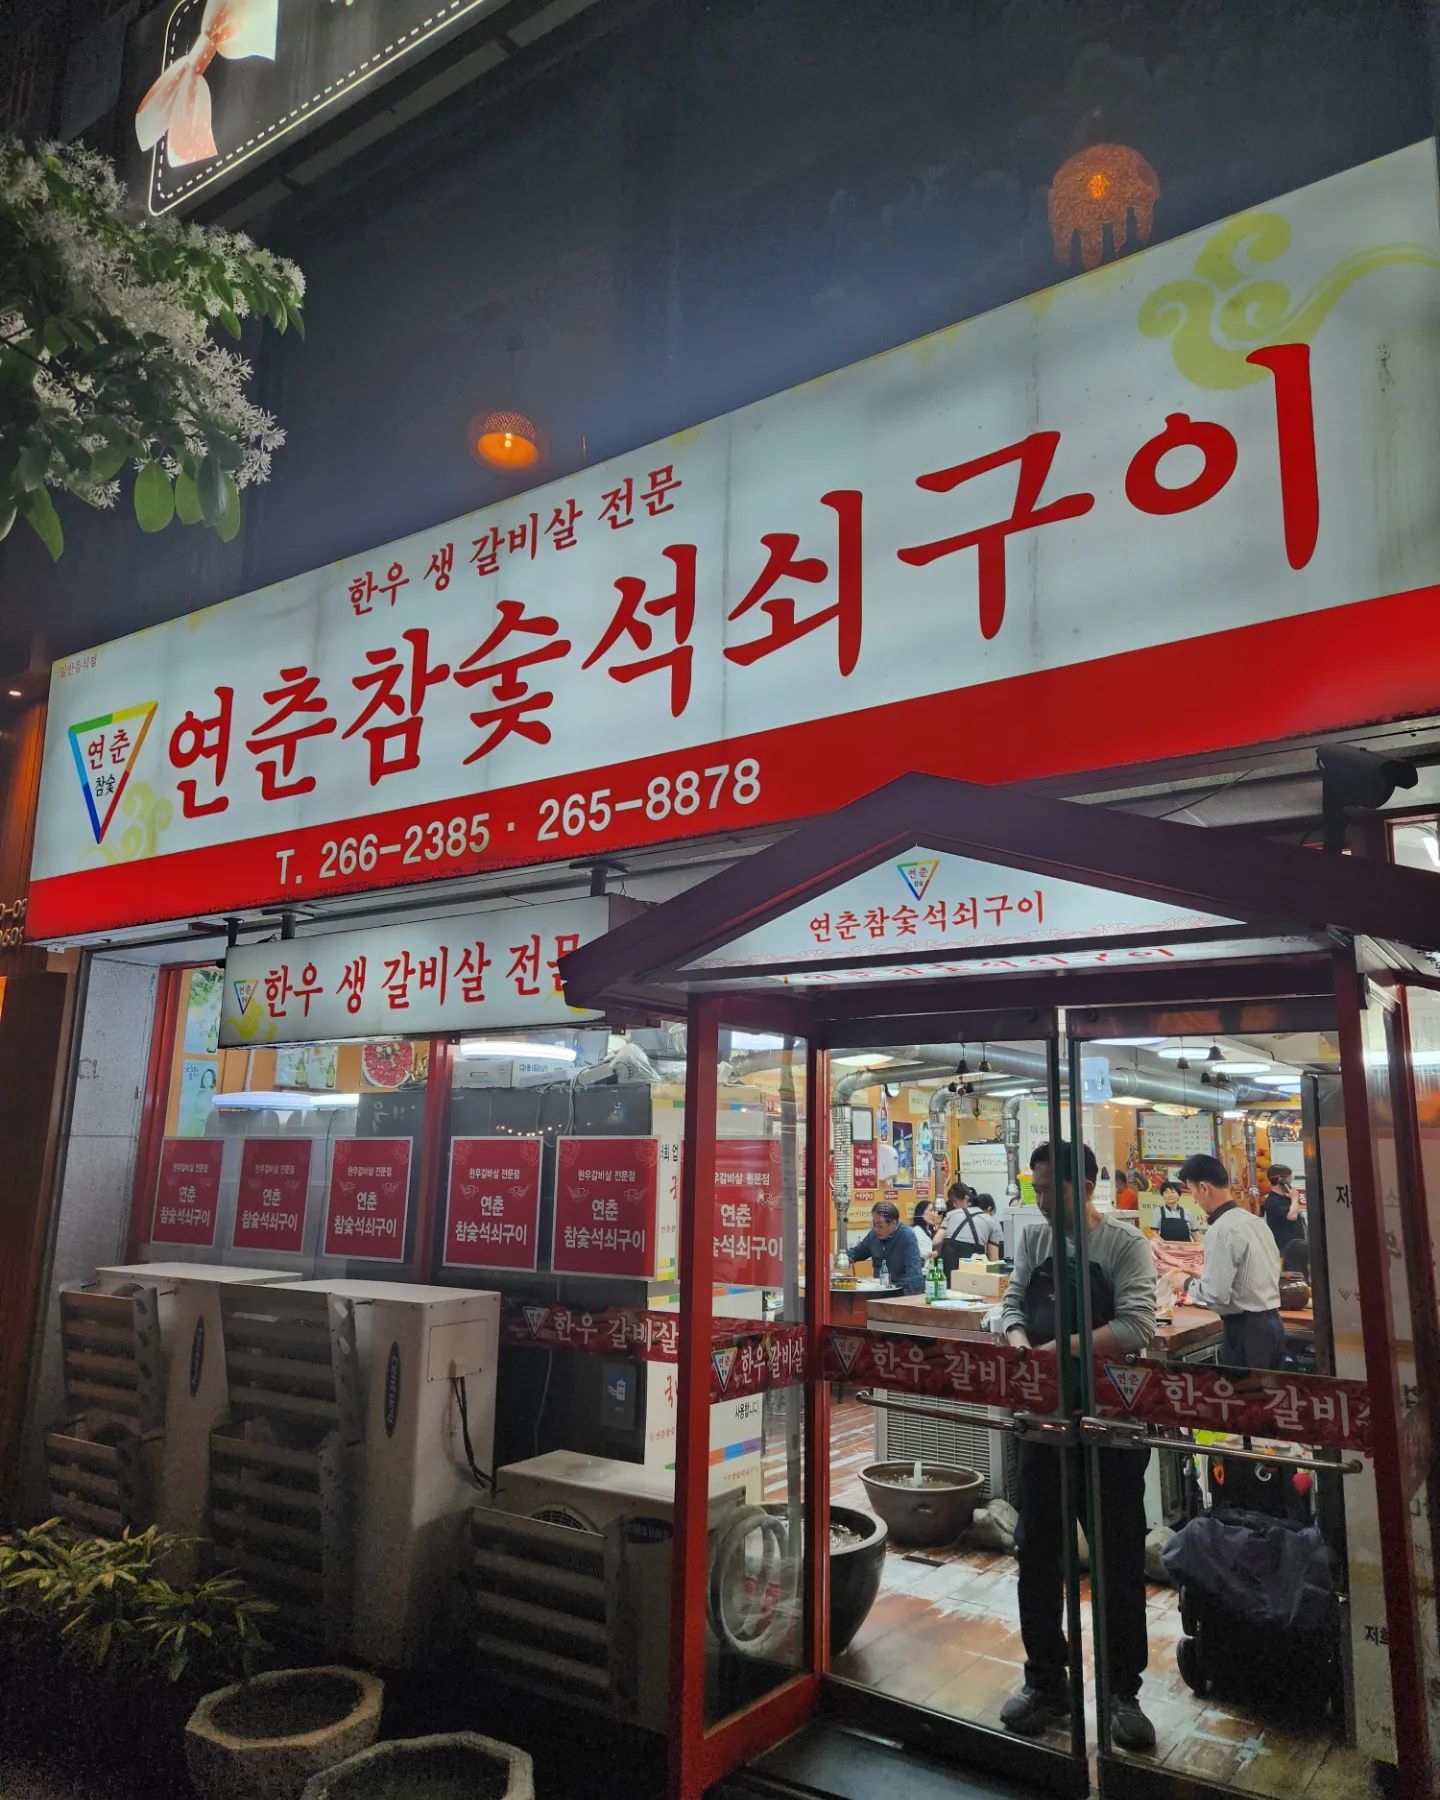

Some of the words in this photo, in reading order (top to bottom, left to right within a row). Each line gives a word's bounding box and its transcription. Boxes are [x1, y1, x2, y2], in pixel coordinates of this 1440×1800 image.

[349, 562, 409, 615] 한우
[423, 543, 454, 591] 생
[469, 498, 584, 576] 갈비살
[598, 464, 682, 529] 전문
[87, 729, 131, 771] 연춘
[94, 773, 117, 797] 참숯
[275, 848, 303, 885] T.
[318, 812, 492, 879] 266-2385
[536, 758, 761, 842] 265-8878
[808, 890, 1044, 943] 연춘참숯석쇠구이
[264, 964, 323, 1018] 한우
[336, 956, 367, 1014] 생
[380, 940, 491, 1011] 갈비살
[577, 1169, 613, 1182] 한우갈비살
[614, 1170, 636, 1182] 전문점
[357, 1191, 377, 1211] 연춘
[480, 1195, 504, 1217] 연춘
[1336, 1184, 1352, 1208] 저
[591, 1199, 619, 1221] 연춘
[720, 1203, 752, 1228] 연춘
[334, 1215, 397, 1238] 참숯석쇠구이
[455, 1220, 527, 1246] 참숯석쇠구이
[564, 1225, 645, 1253] 참숯석쇠구이
[713, 1234, 783, 1261] 석쇠구이
[553, 1310, 599, 1345] 한우
[607, 1314, 680, 1355] 갈비살
[741, 1343, 766, 1384] 한우
[770, 1336, 805, 1379] 갈비살
[871, 1341, 931, 1384] 한우
[944, 1350, 1048, 1401] 갈비살
[1160, 1372, 1245, 1422] 한우
